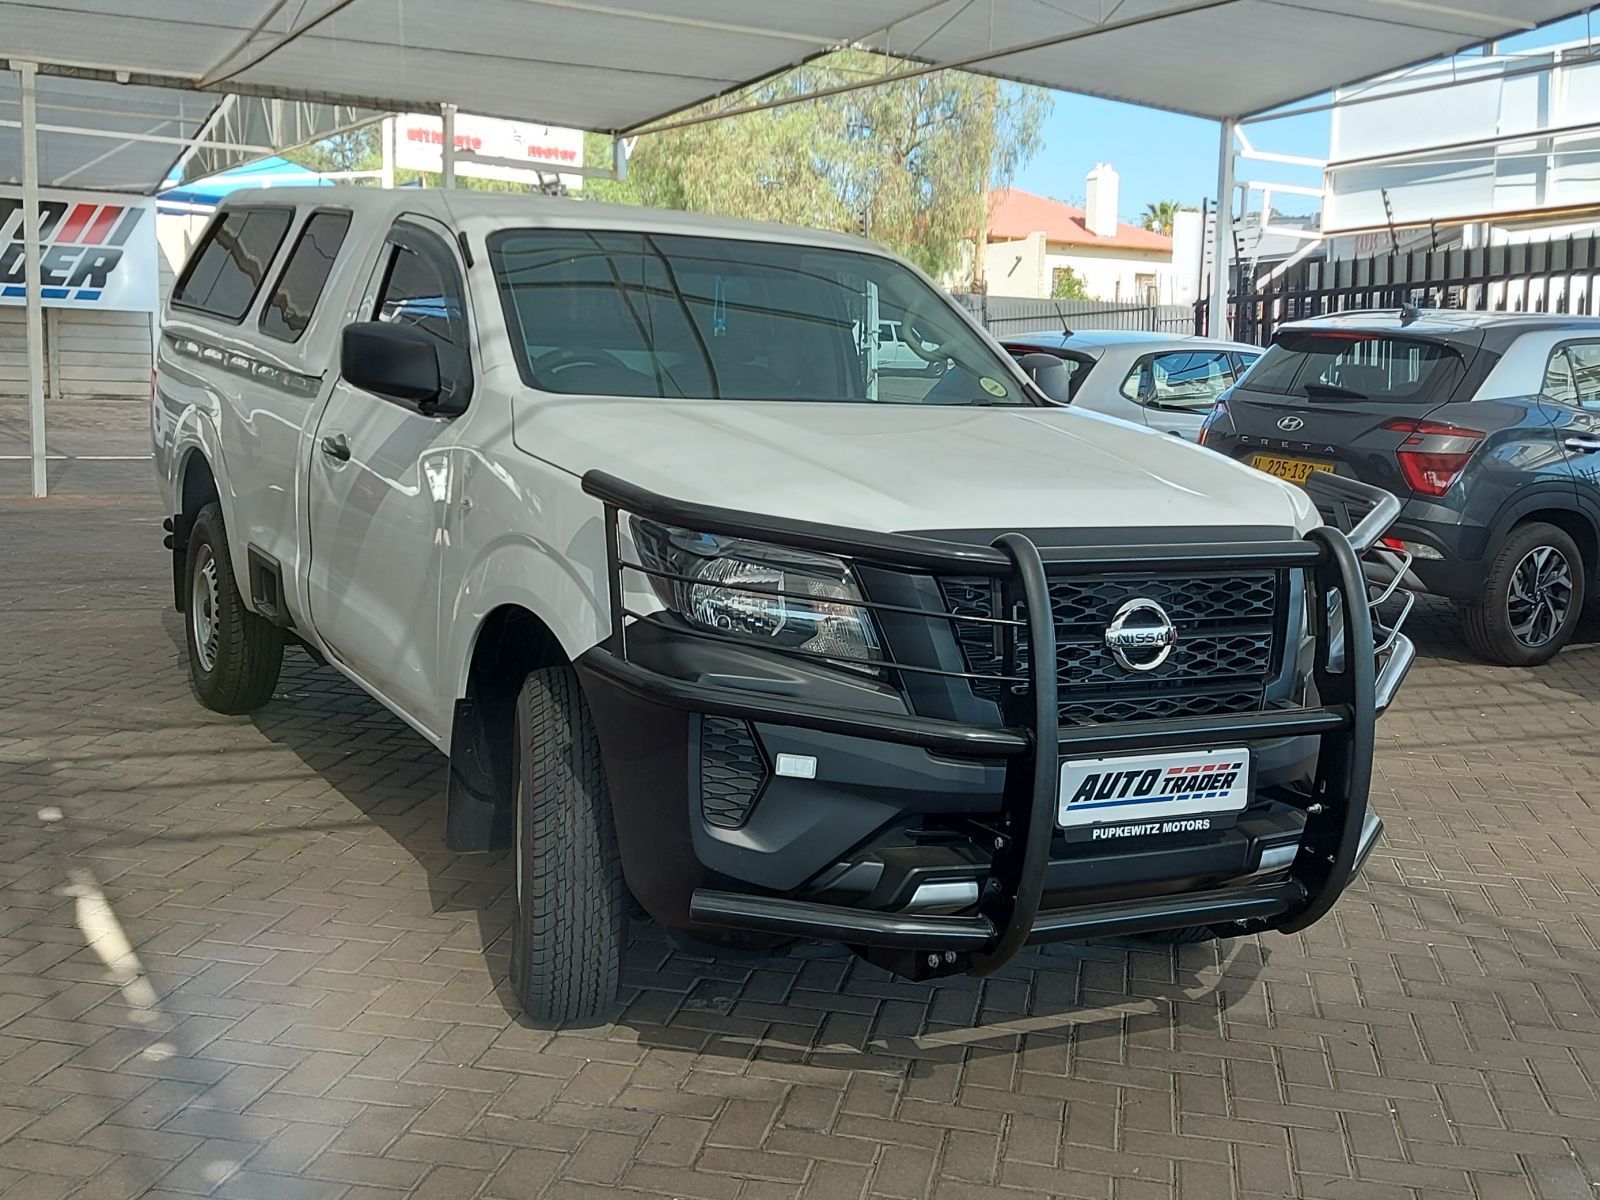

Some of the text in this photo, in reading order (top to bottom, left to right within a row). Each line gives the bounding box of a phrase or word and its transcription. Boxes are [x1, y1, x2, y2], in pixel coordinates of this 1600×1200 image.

[1241, 435, 1335, 453] CRETA
[1117, 630, 1173, 645] NISSAN
[1070, 769, 1238, 803] AUTO TRADER
[1092, 819, 1210, 840] PUPKEWITZ MOTORS
